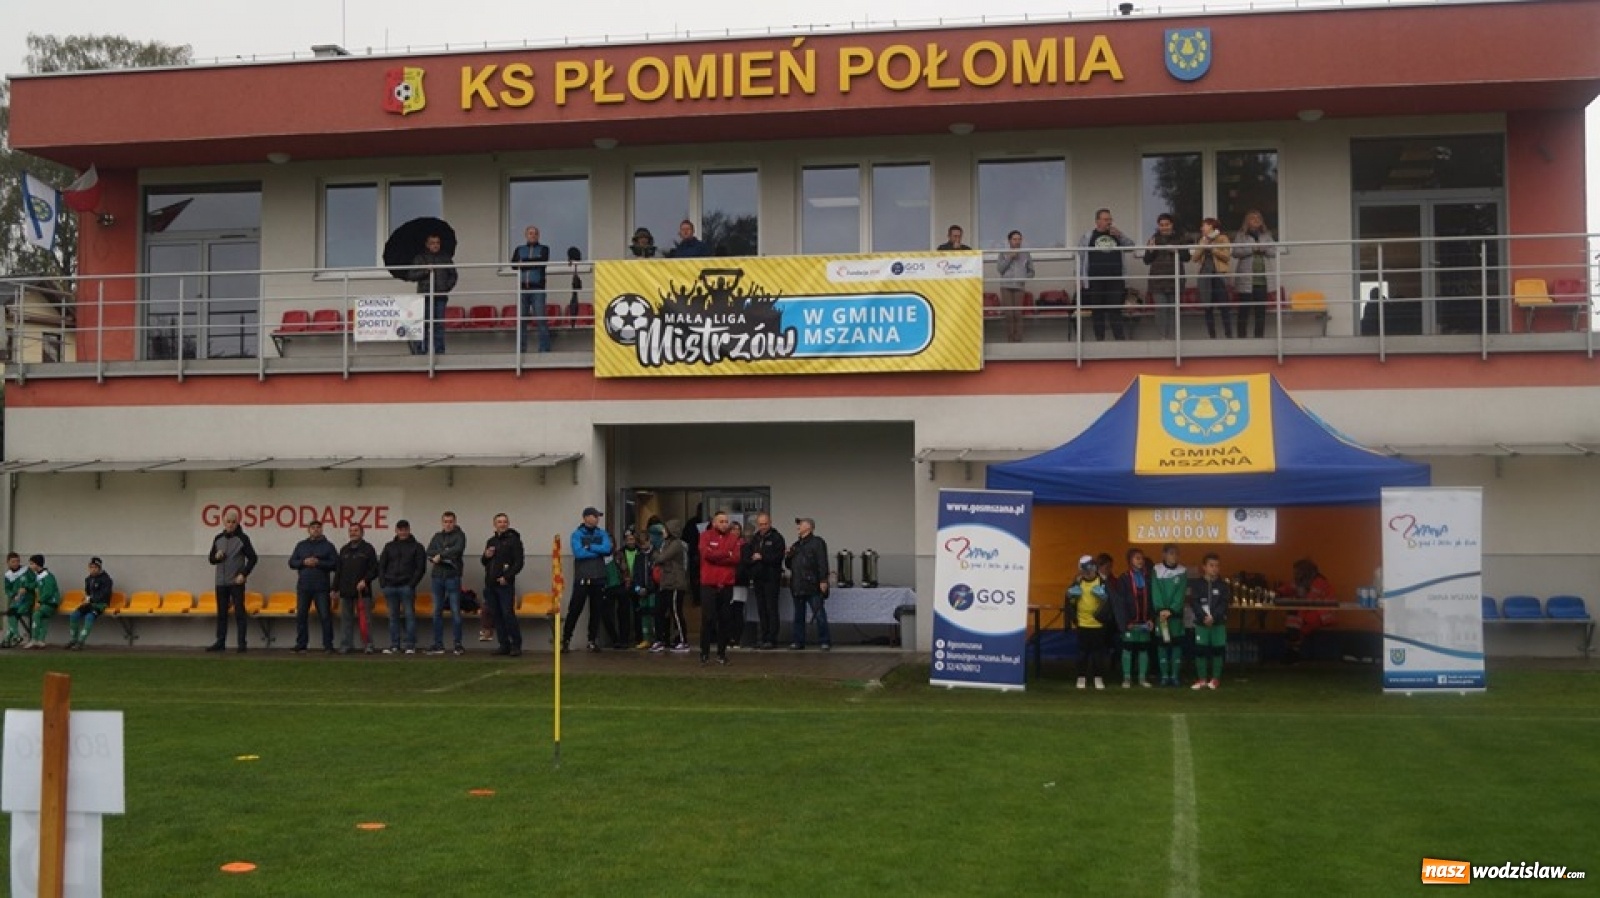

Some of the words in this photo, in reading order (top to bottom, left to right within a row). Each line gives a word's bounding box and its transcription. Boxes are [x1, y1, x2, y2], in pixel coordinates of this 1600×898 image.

[461, 62, 536, 110] KS
[554, 37, 817, 105] PŁOMIEŃ
[838, 34, 1125, 94] POŁOMIA
[664, 312, 703, 324] MAŁA
[714, 312, 747, 324] LIGA
[803, 307, 825, 324] W
[832, 304, 918, 324] GMINIE
[358, 320, 392, 328] SPORTU
[638, 316, 796, 366] Mistrzów
[803, 325, 902, 346] MSZANA
[1170, 446, 1242, 457] GMINA
[1159, 456, 1252, 467] MSZANA
[201, 504, 390, 529] GOSPODARZE
[1154, 508, 1205, 522] BIURO
[976, 589, 1016, 605] GOS
